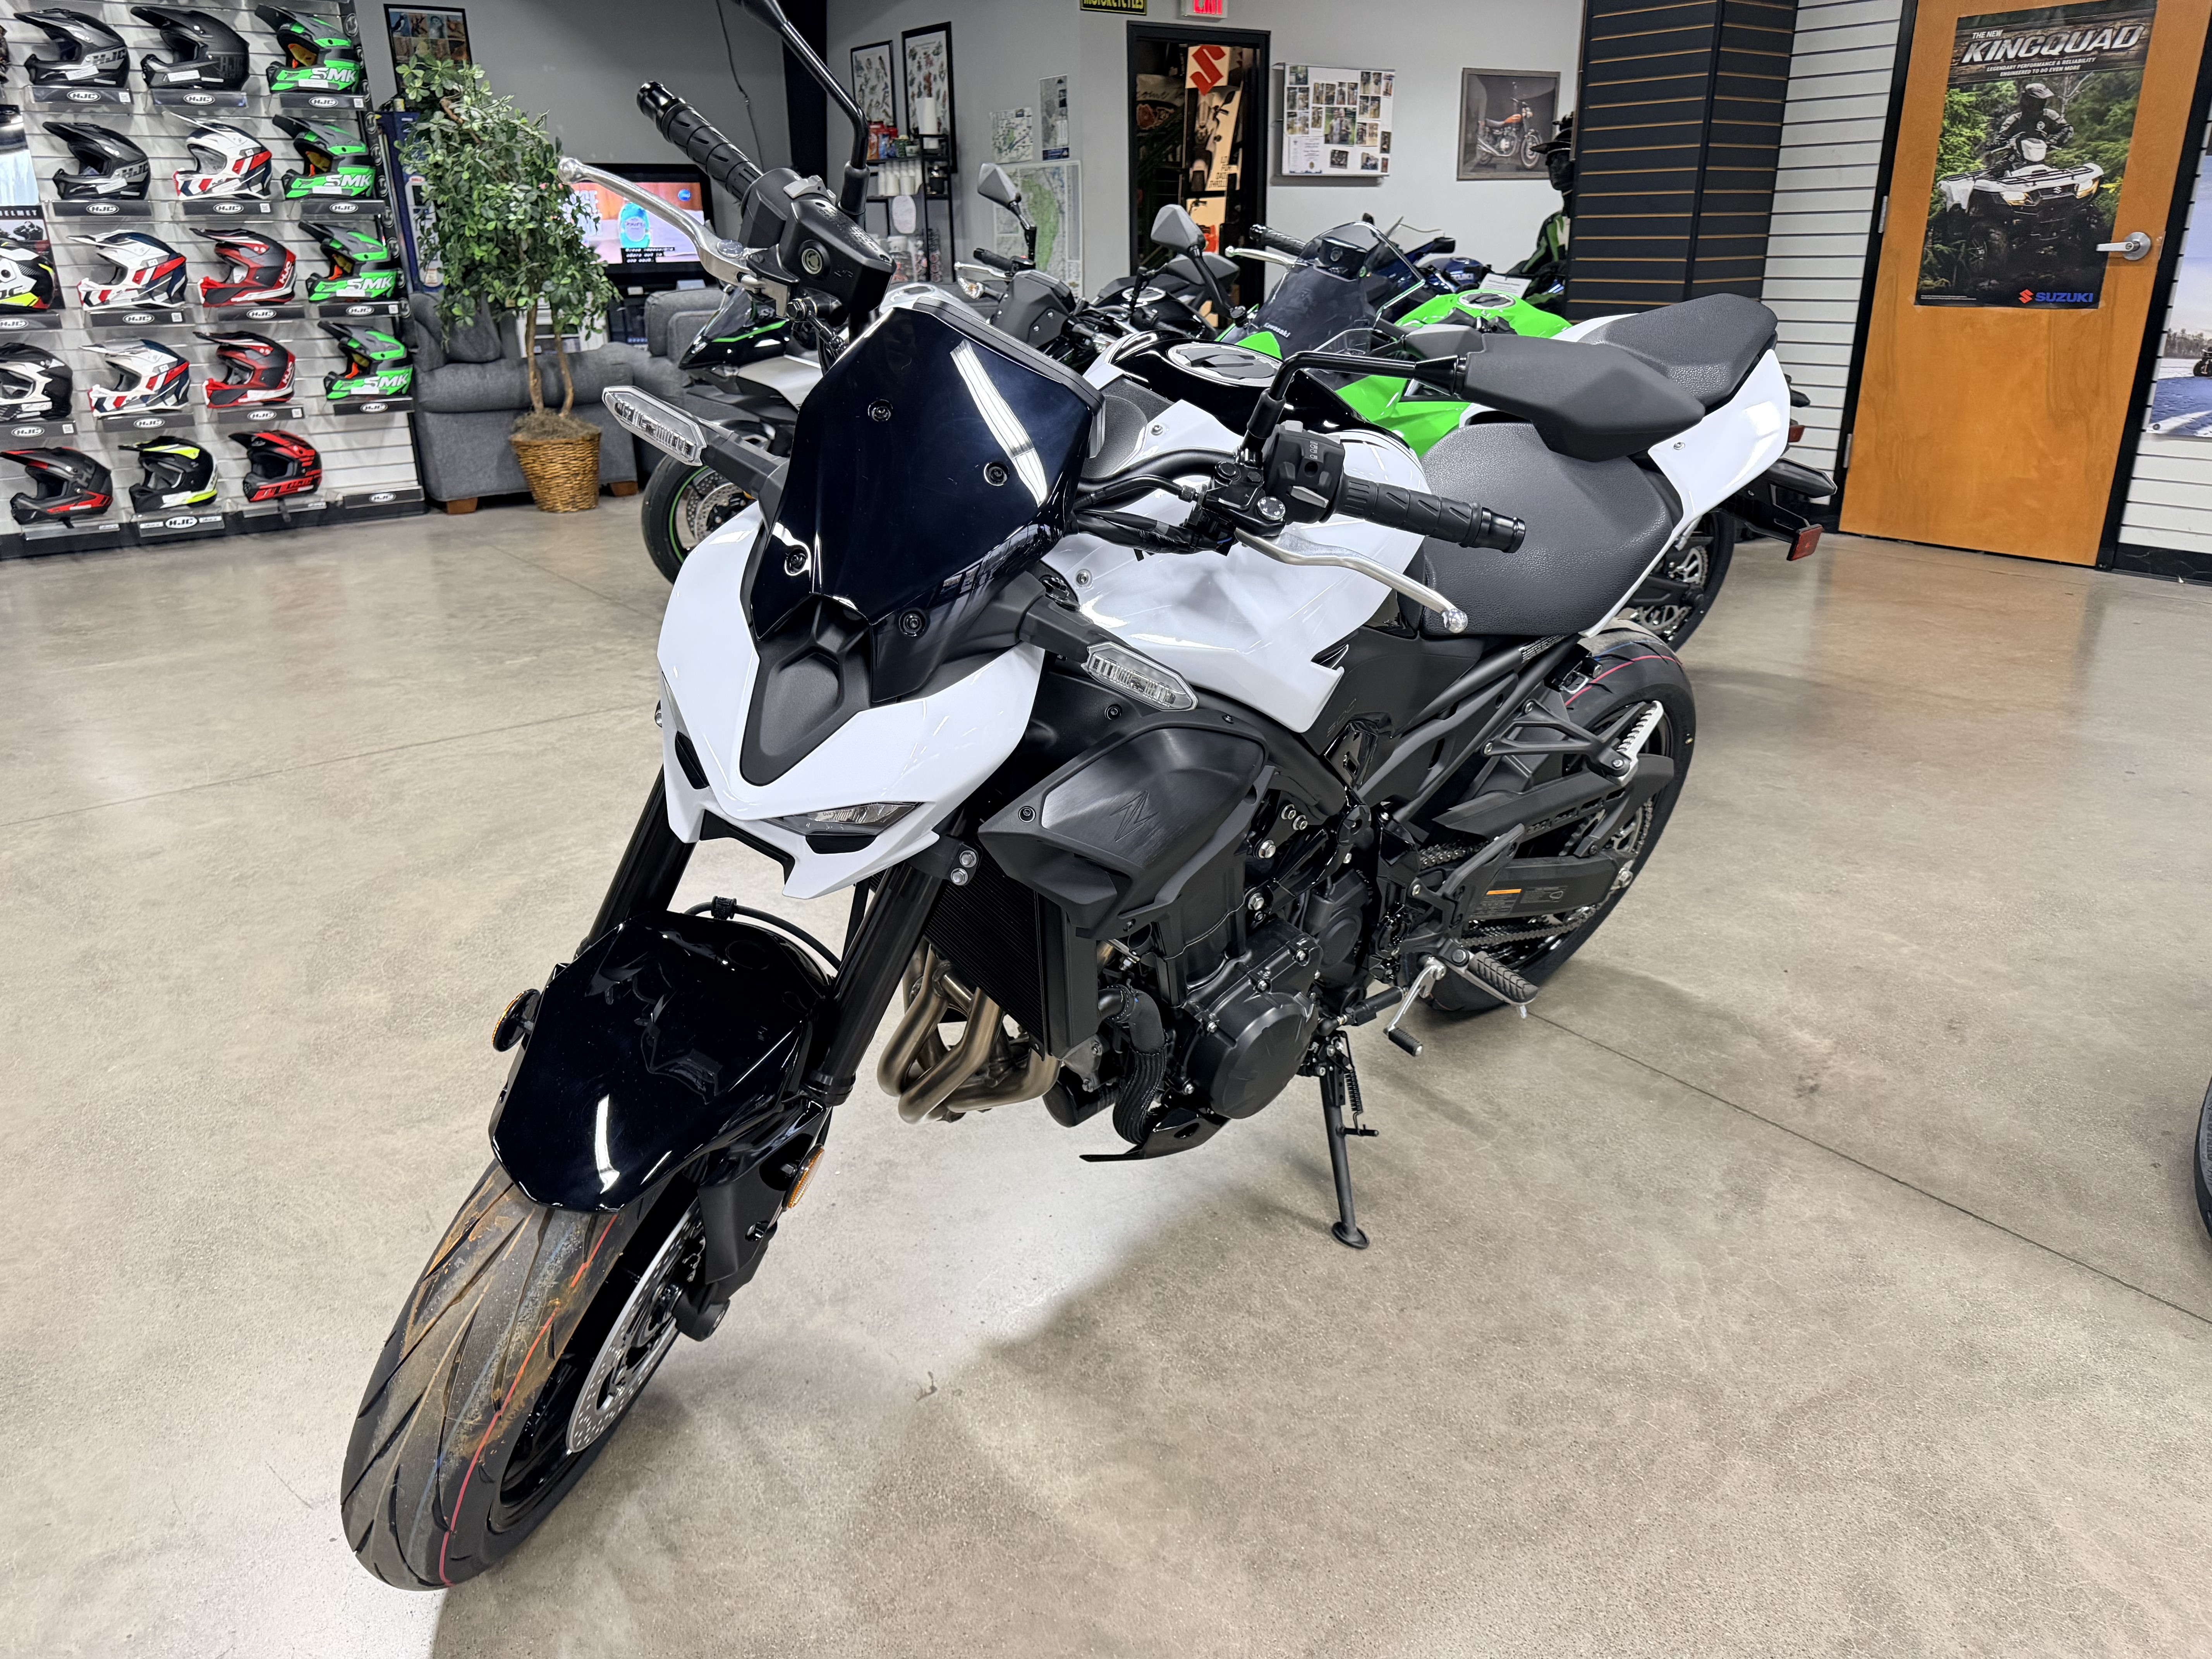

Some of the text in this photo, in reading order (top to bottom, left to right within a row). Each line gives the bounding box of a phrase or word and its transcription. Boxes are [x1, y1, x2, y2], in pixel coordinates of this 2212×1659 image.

[1987, 29, 2003, 38] NEW
[1961, 26, 2145, 63] KINGQUAD
[2017, 60, 2056, 69] PERFORMANCE
[310, 67, 356, 82] SMK
[323, 174, 372, 187] SMK
[345, 276, 392, 290] SMK
[2035, 292, 2093, 302] SUZUKI
[1263, 323, 1291, 338] Kawasaki
[361, 373, 409, 388] SMK
